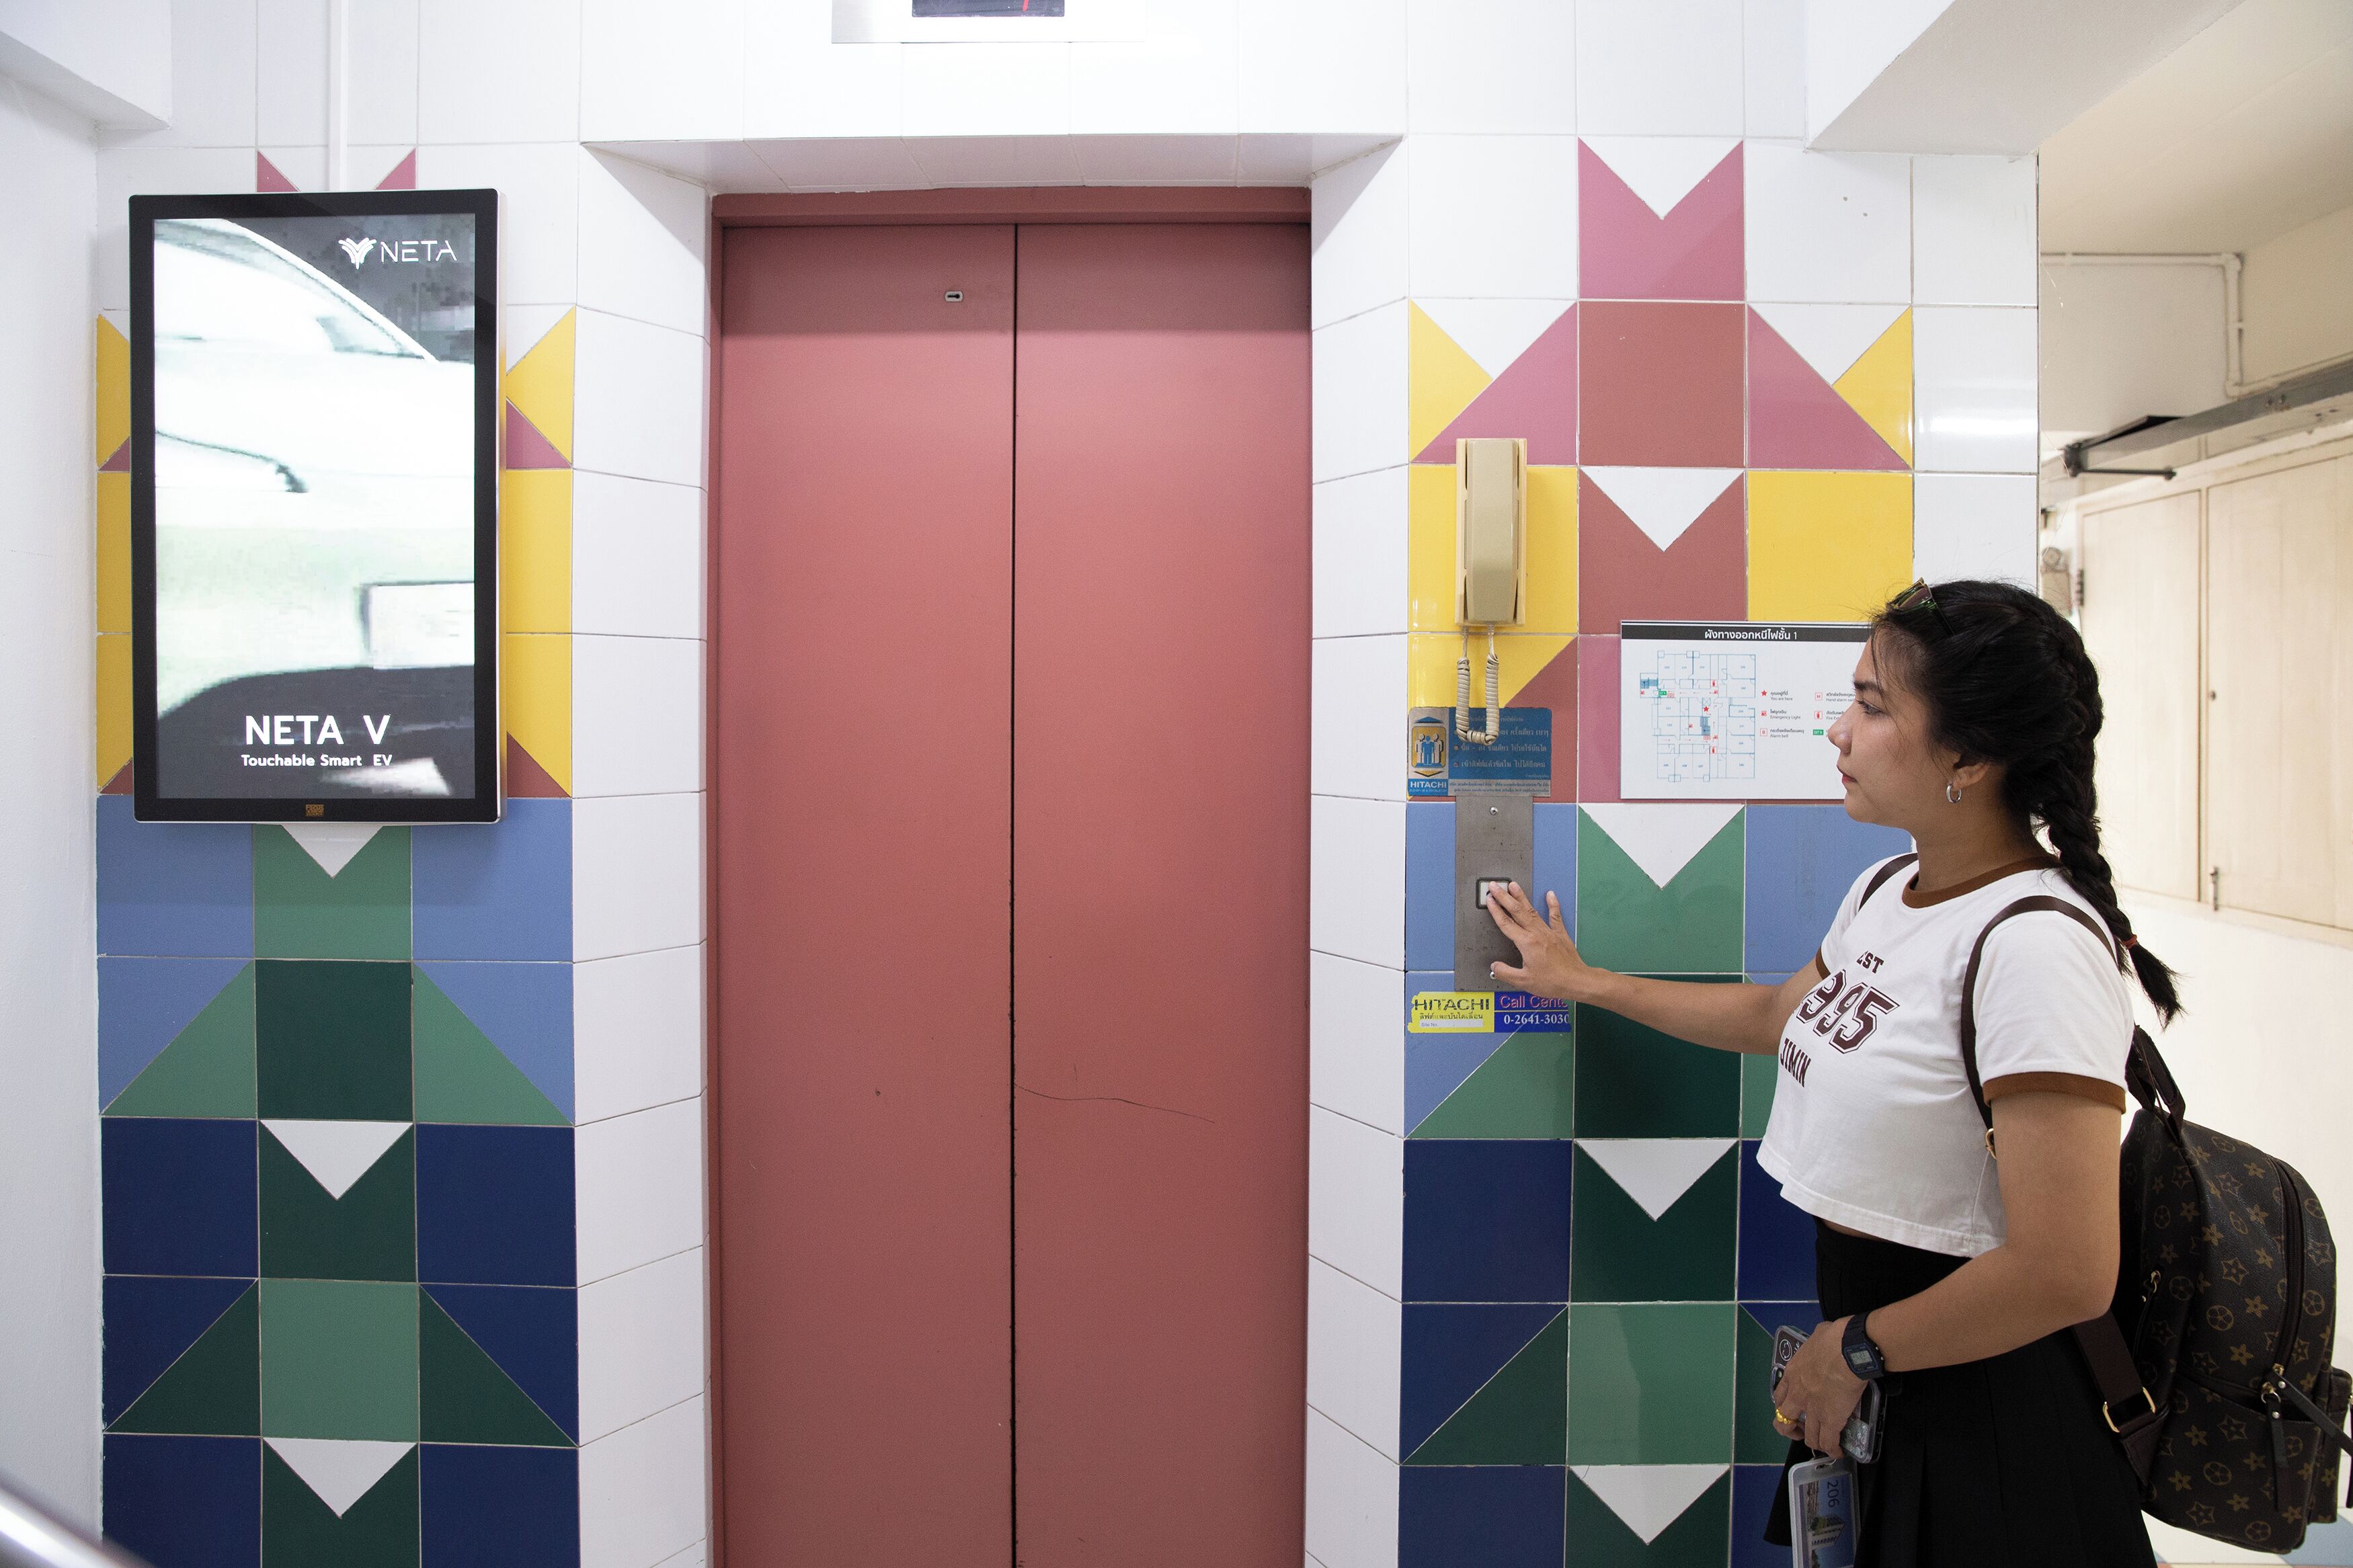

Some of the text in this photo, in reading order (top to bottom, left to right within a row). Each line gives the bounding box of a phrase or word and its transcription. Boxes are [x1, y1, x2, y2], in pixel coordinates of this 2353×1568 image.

[380, 239, 458, 263] NETA
[1704, 627, 1798, 641] ผังทางออกหนีไฟชั้น 1
[245, 715, 390, 745] NETA V
[241, 753, 393, 768] Touchable Smart EV
[1410, 780, 1447, 788] HITACHI
[1414, 999, 1490, 1011] HITACHI
[1500, 995, 1525, 1008] Call
[1503, 1014, 1569, 1025] 0-2641-3030
[1780, 1038, 1812, 1087] JIMIN
[1827, 1479, 1839, 1508] 206
